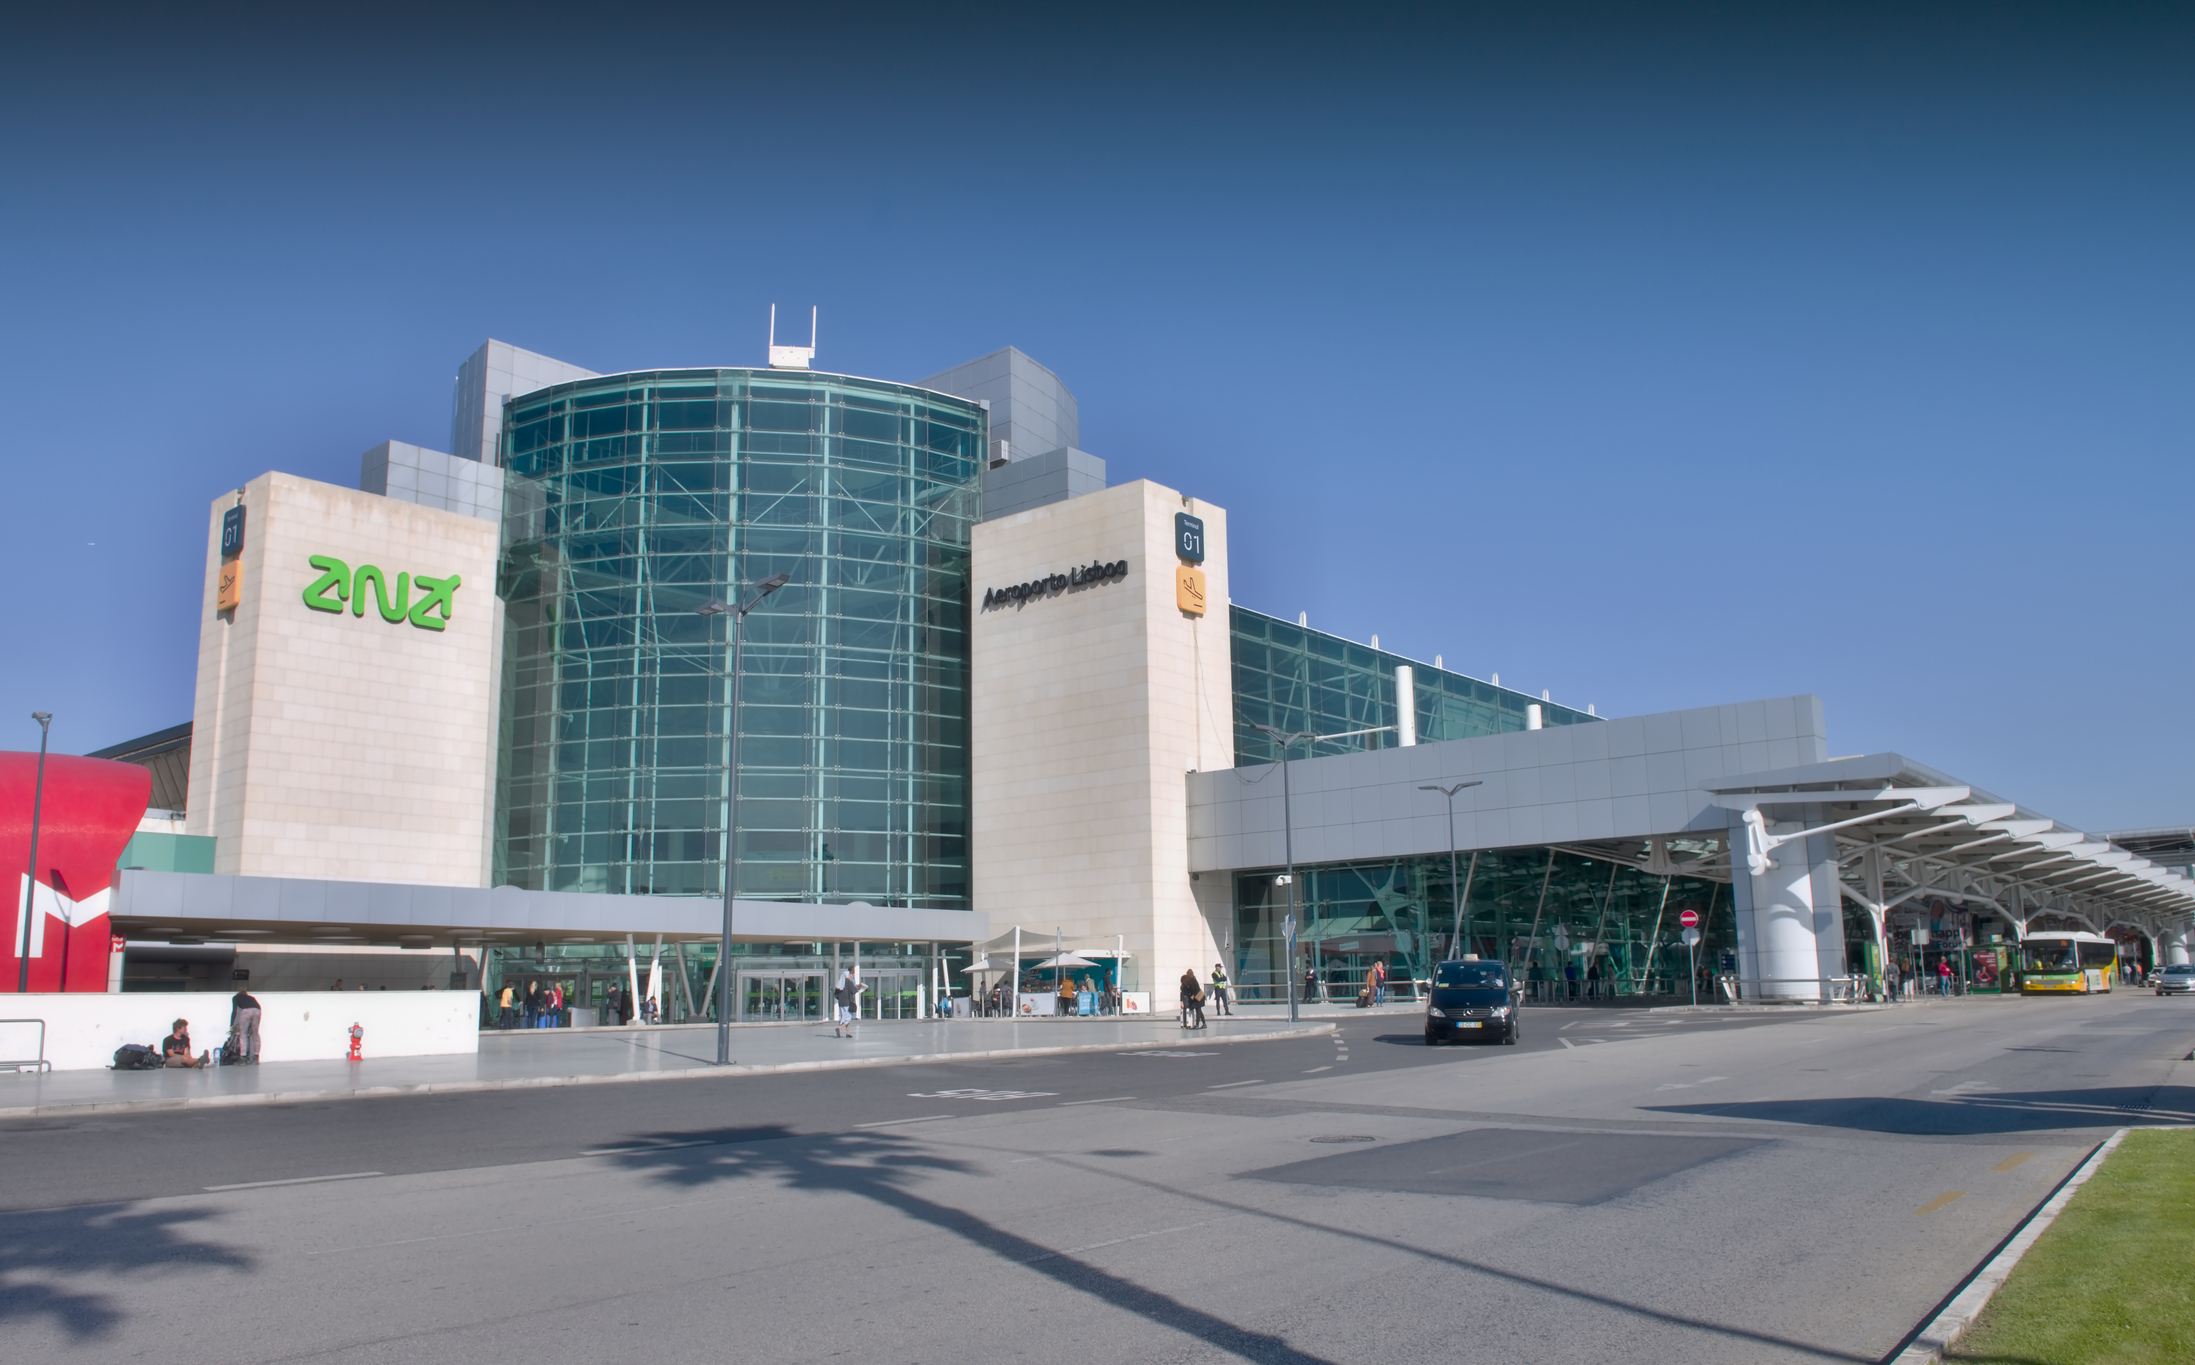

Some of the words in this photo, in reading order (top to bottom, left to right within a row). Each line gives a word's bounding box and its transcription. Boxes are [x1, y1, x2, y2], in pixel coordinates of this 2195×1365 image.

[225, 524, 238, 547] 01
[1183, 519, 1200, 530] Terminal
[1183, 532, 1200, 554] 01
[983, 572, 1068, 607] Aeroporto
[1071, 560, 1128, 588] Lisboa
